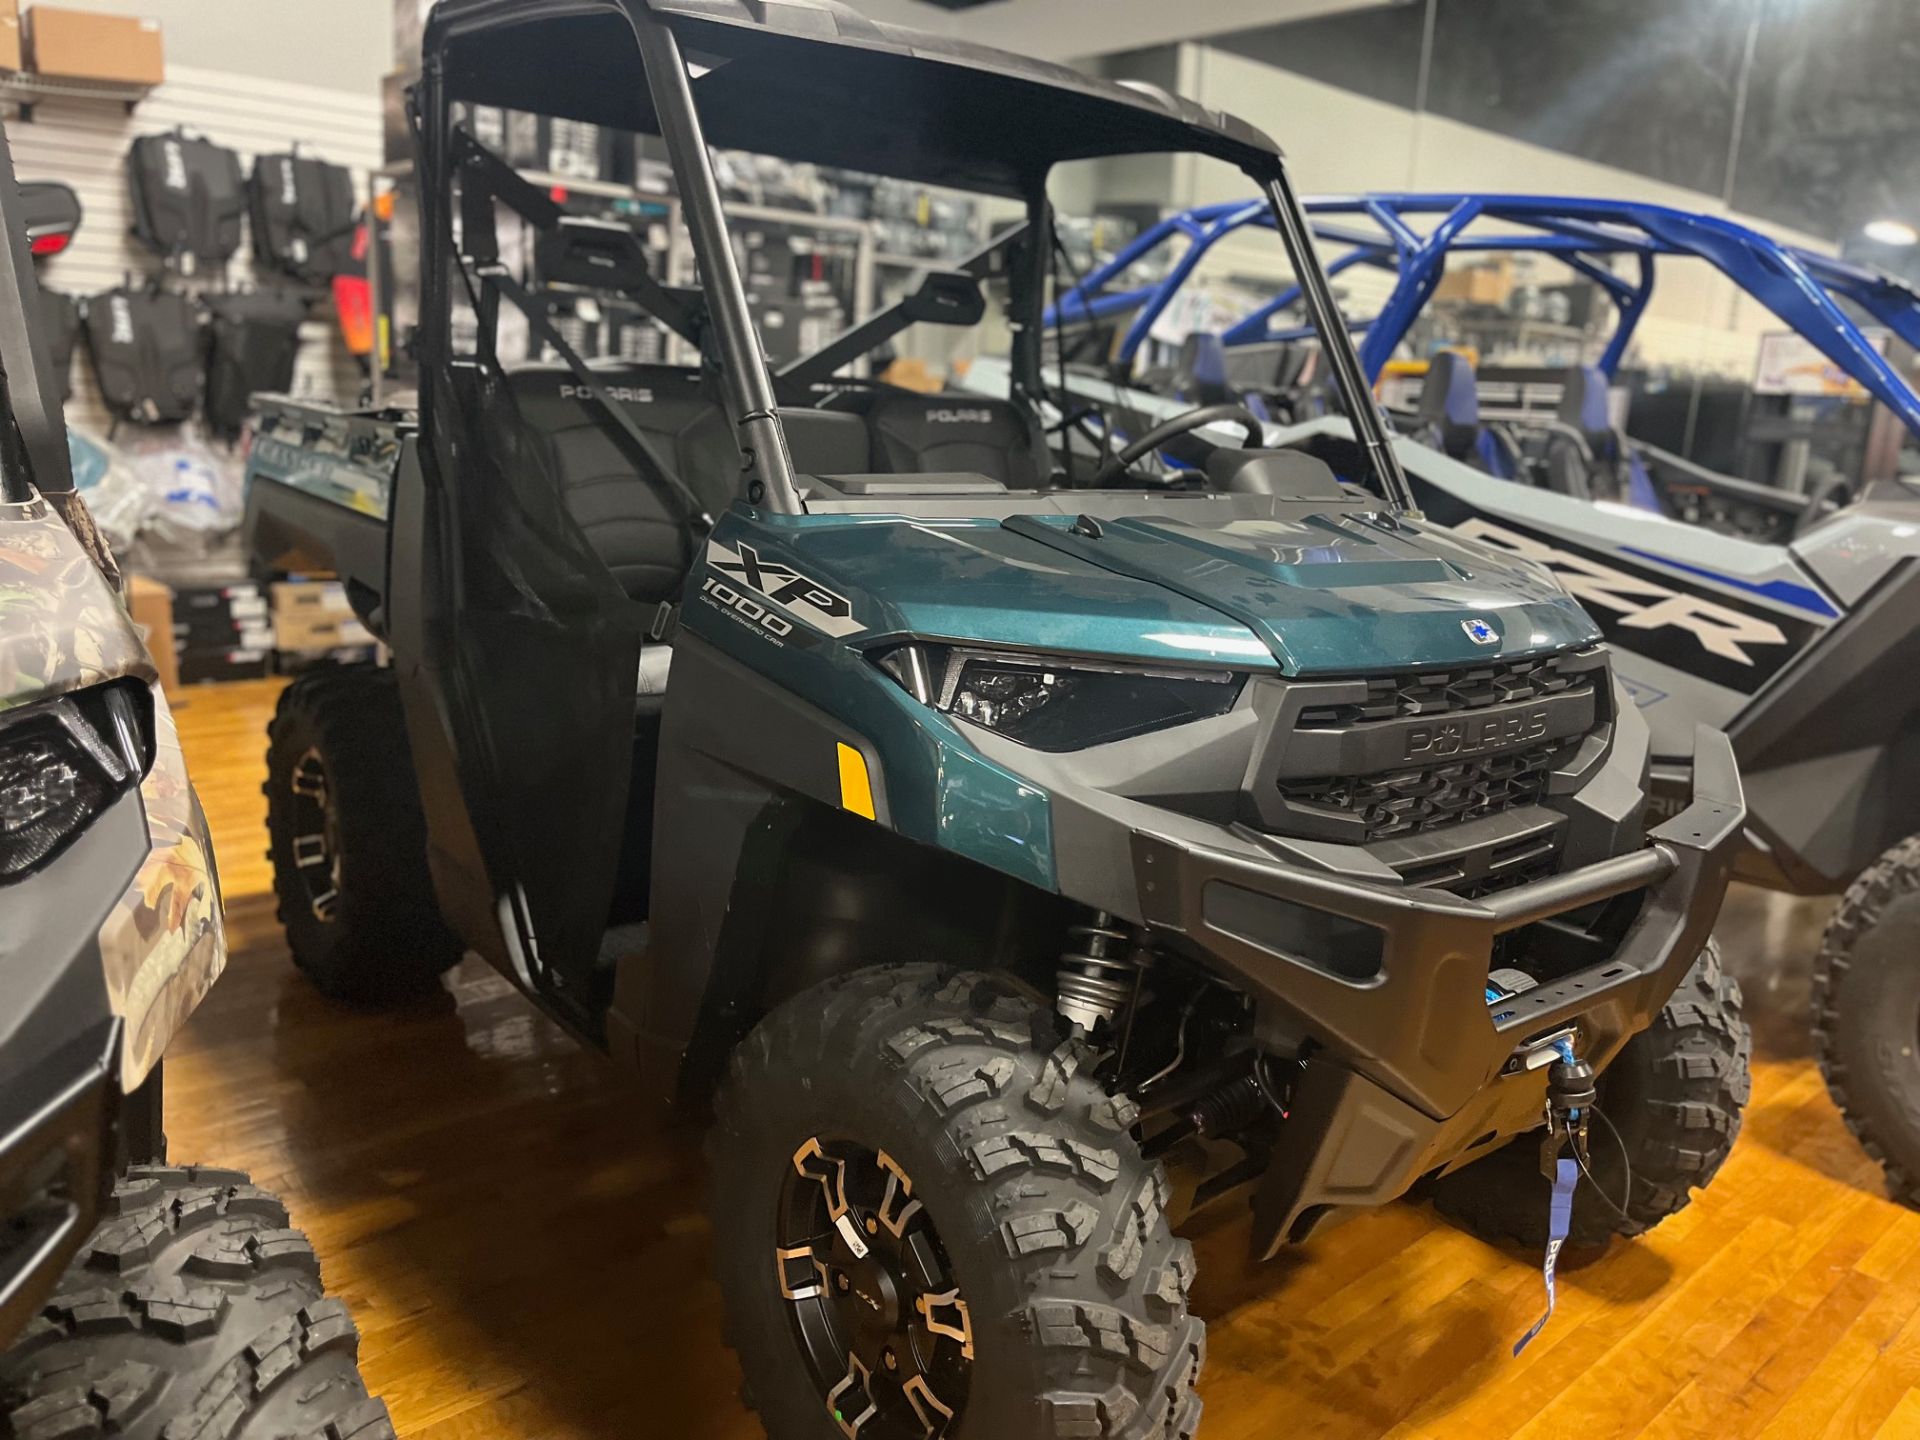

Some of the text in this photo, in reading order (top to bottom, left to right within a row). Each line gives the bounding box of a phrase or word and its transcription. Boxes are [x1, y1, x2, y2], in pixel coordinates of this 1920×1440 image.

[560, 384, 653, 402] POARIS
[925, 409, 992, 423] POLARIS
[706, 539, 855, 620] XP
[699, 595, 785, 649] DUAL OVERHEAD CAM
[702, 577, 793, 637] 1000
[1403, 709, 1548, 761] POLARIS
